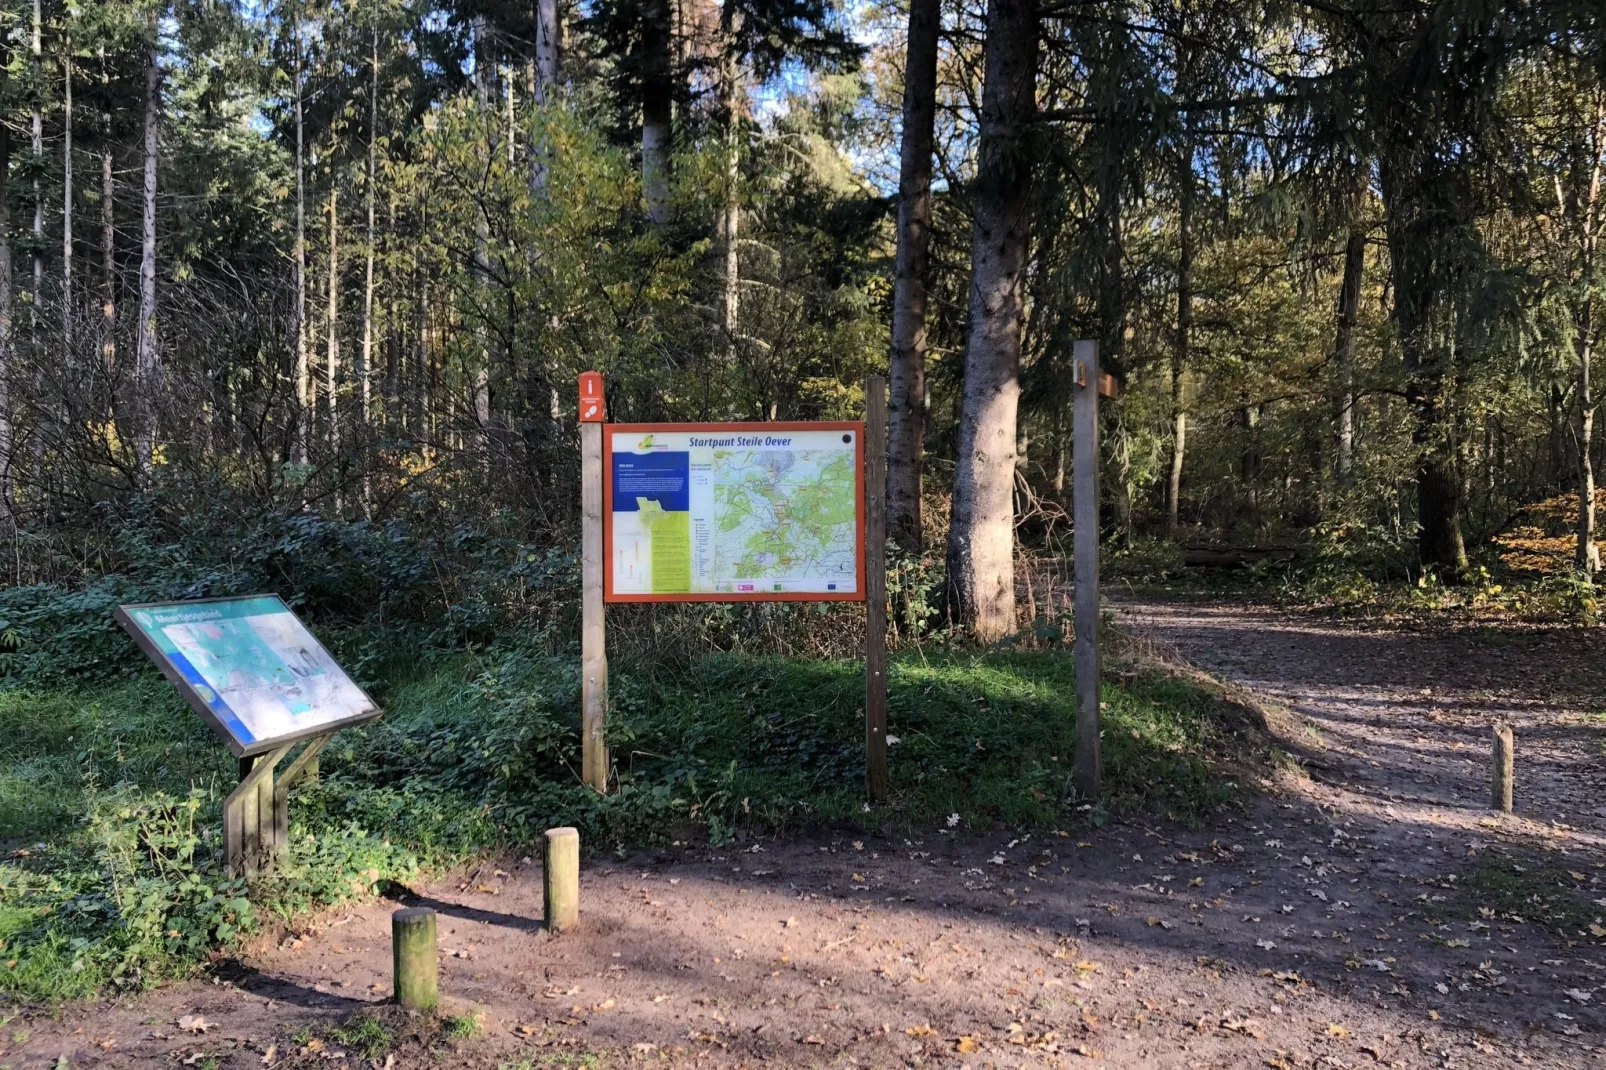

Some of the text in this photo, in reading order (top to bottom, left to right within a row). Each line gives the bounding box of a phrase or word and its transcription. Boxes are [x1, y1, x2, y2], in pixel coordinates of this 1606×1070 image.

[689, 436, 792, 449] Startpunt Steile Oever
